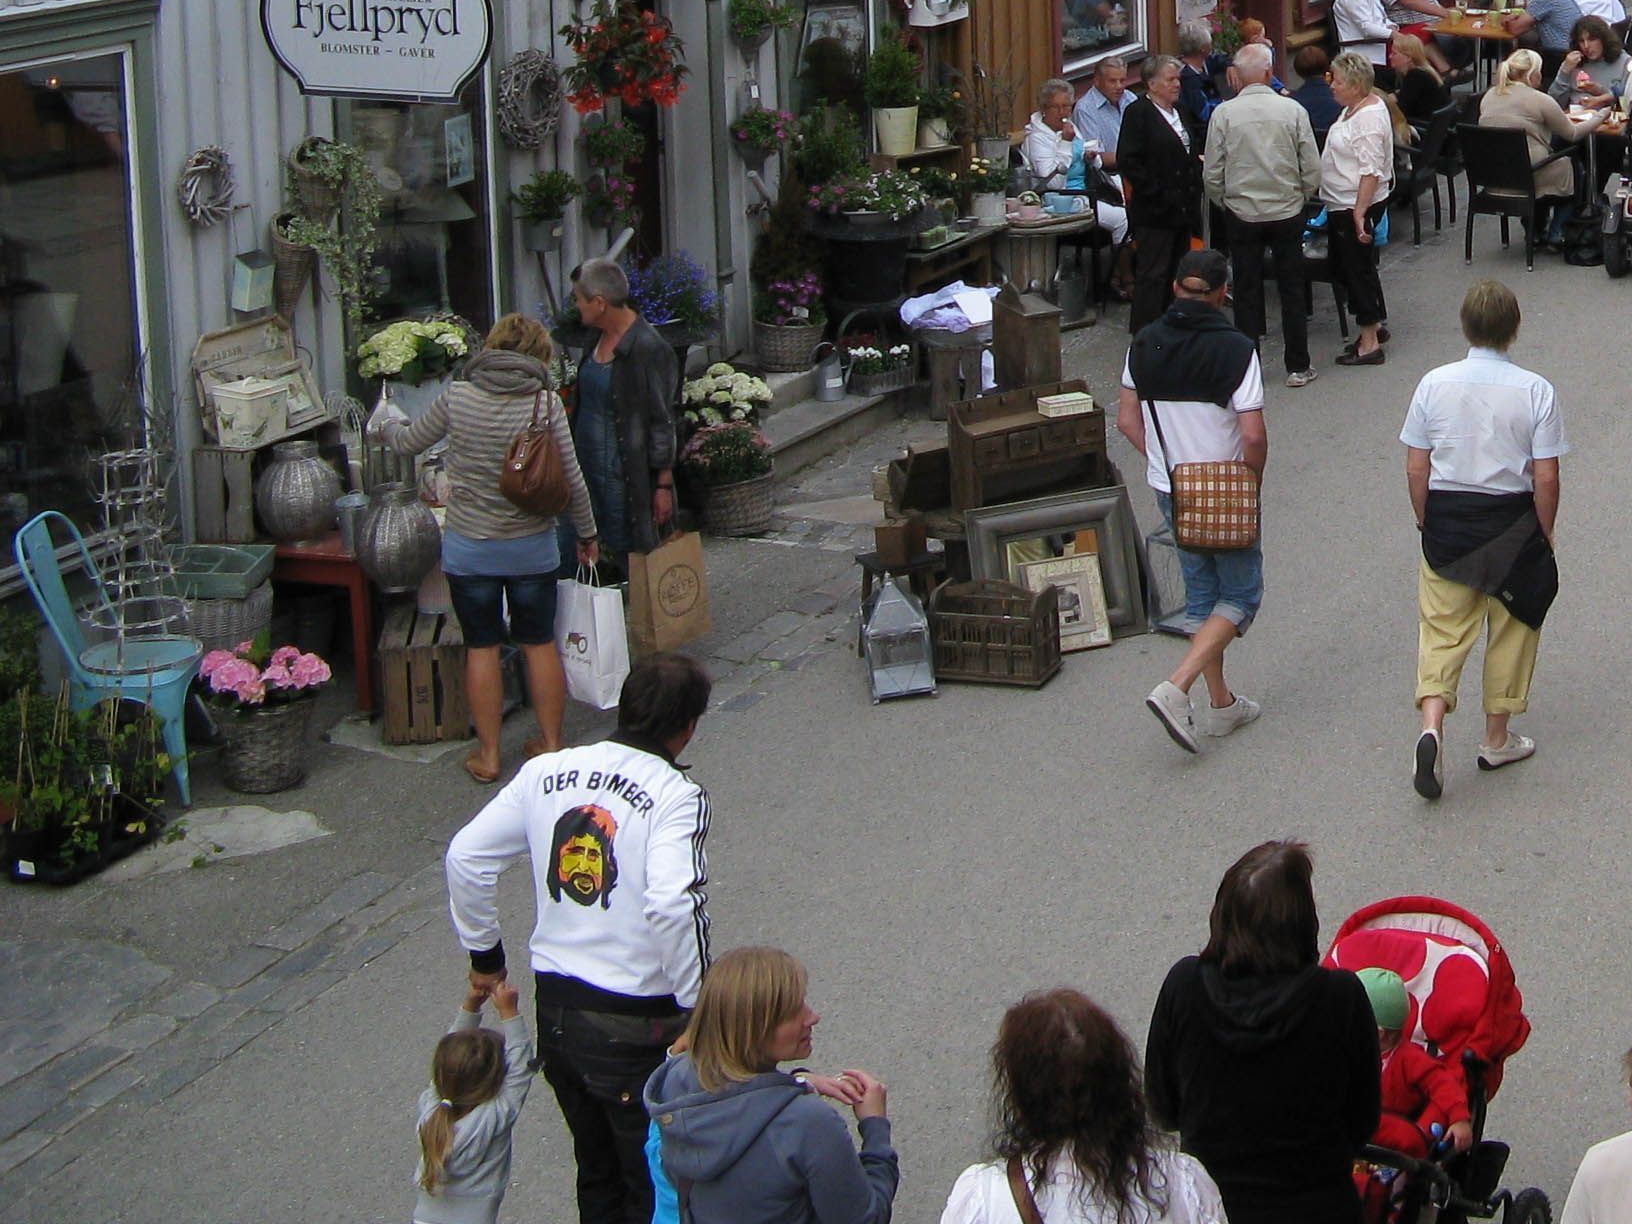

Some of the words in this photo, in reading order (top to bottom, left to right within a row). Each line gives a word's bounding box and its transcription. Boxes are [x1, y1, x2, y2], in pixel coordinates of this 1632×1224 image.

[320, 42, 381, 57] BLOMSTER
[399, 46, 436, 59] GAVER
[543, 769, 580, 796] DER
[585, 771, 655, 820] BIMBER
